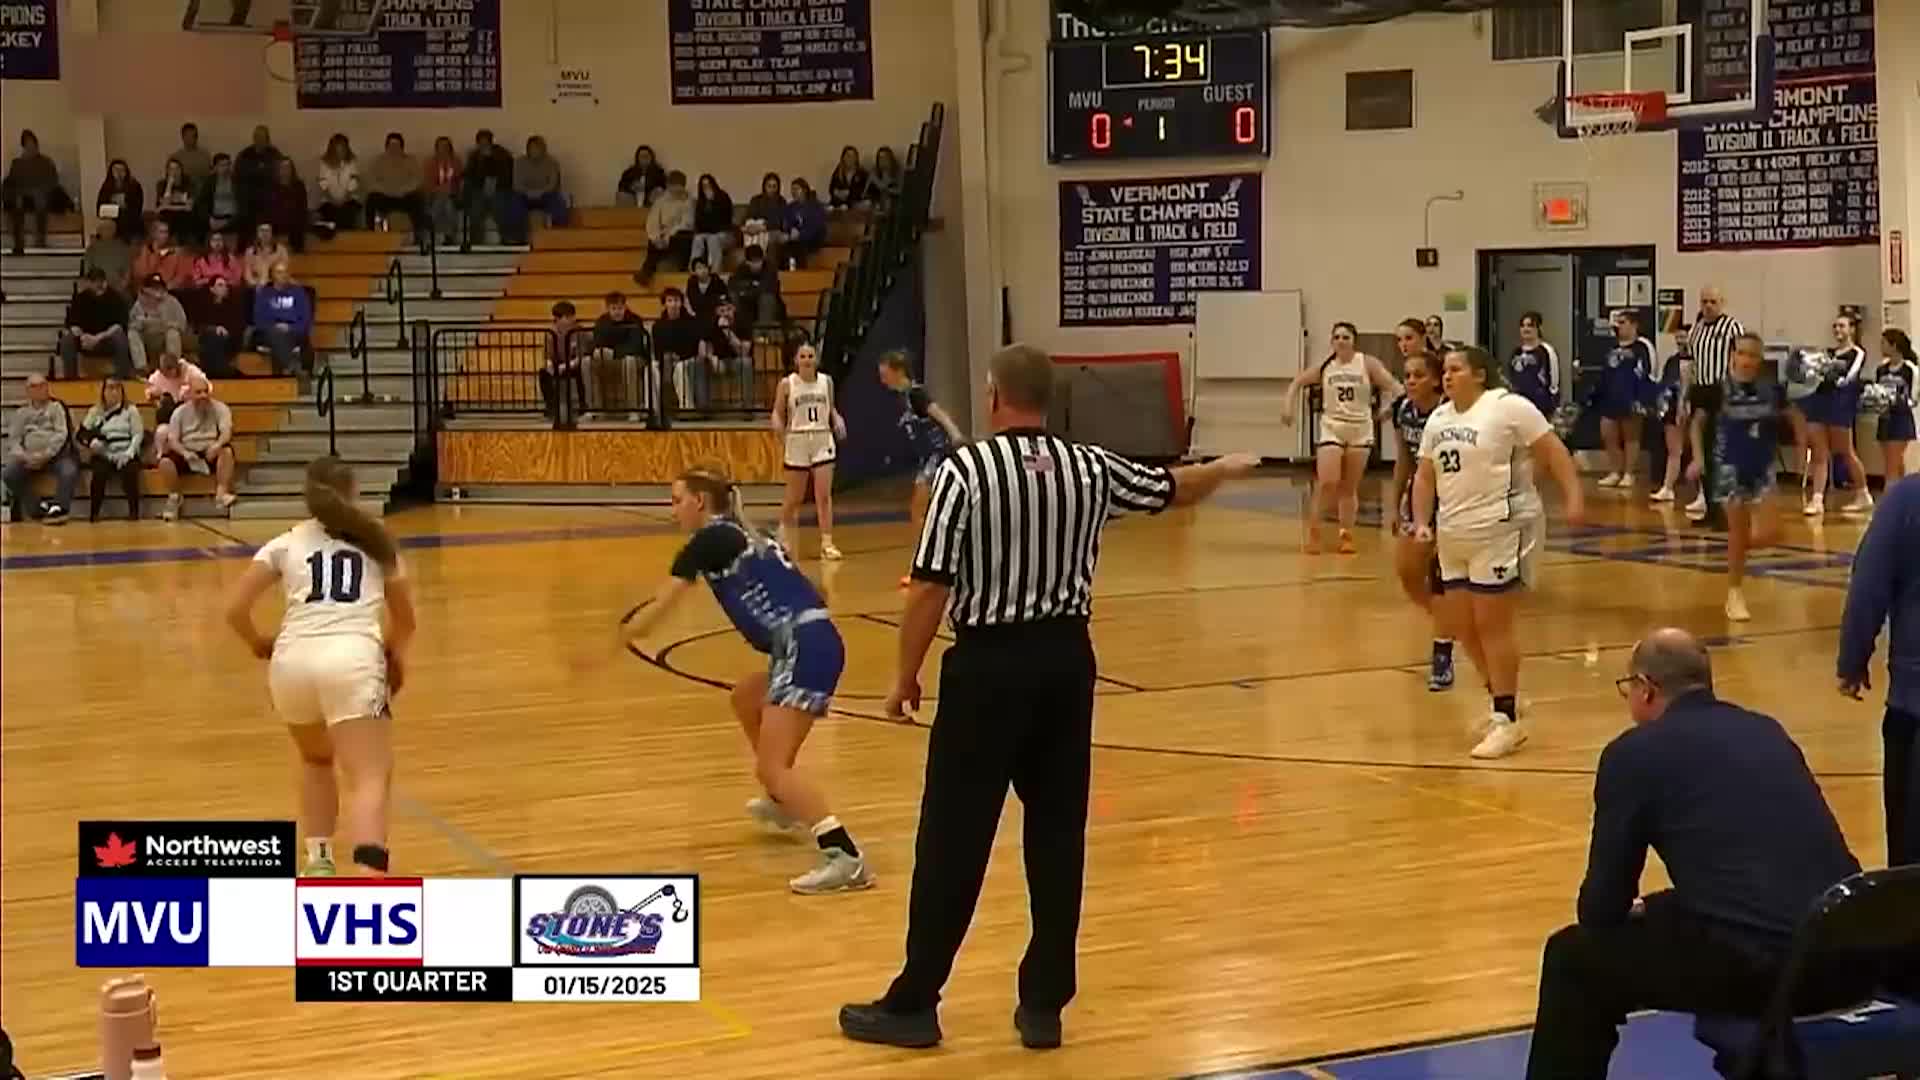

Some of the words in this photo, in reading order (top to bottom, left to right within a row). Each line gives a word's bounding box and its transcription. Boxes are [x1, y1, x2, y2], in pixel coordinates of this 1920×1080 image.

[759, 10, 796, 26] TRACK
[810, 8, 844, 24] FIELD
[1134, 43, 1205, 79] 7:34
[561, 70, 589, 81] MVU
[1068, 90, 1103, 109] MVU
[1203, 83, 1254, 103] GUEST
[1138, 96, 1177, 111] PERIOD
[1092, 112, 1111, 149] 0
[1158, 115, 1166, 142] 1
[1235, 106, 1256, 144] 0
[1705, 131, 1757, 152] DIVISION
[1761, 130, 1774, 149] II
[1778, 126, 1821, 148] TRACK
[1840, 123, 1878, 144] FIELD
[1682, 159, 1711, 174] 2012
[1805, 152, 1842, 167] RELAY
[1111, 182, 1210, 205] VERMONT
[1082, 205, 1136, 225] STATE
[1140, 201, 1240, 223] CHAMPIONS
[1084, 225, 1131, 243] DIVISION
[1134, 224, 1145, 242] II
[1150, 223, 1188, 241] TRACK
[1203, 221, 1238, 239] FIELD
[1337, 386, 1355, 403] 20
[1439, 449, 1462, 474] 23
[305, 550, 363, 604] 10
